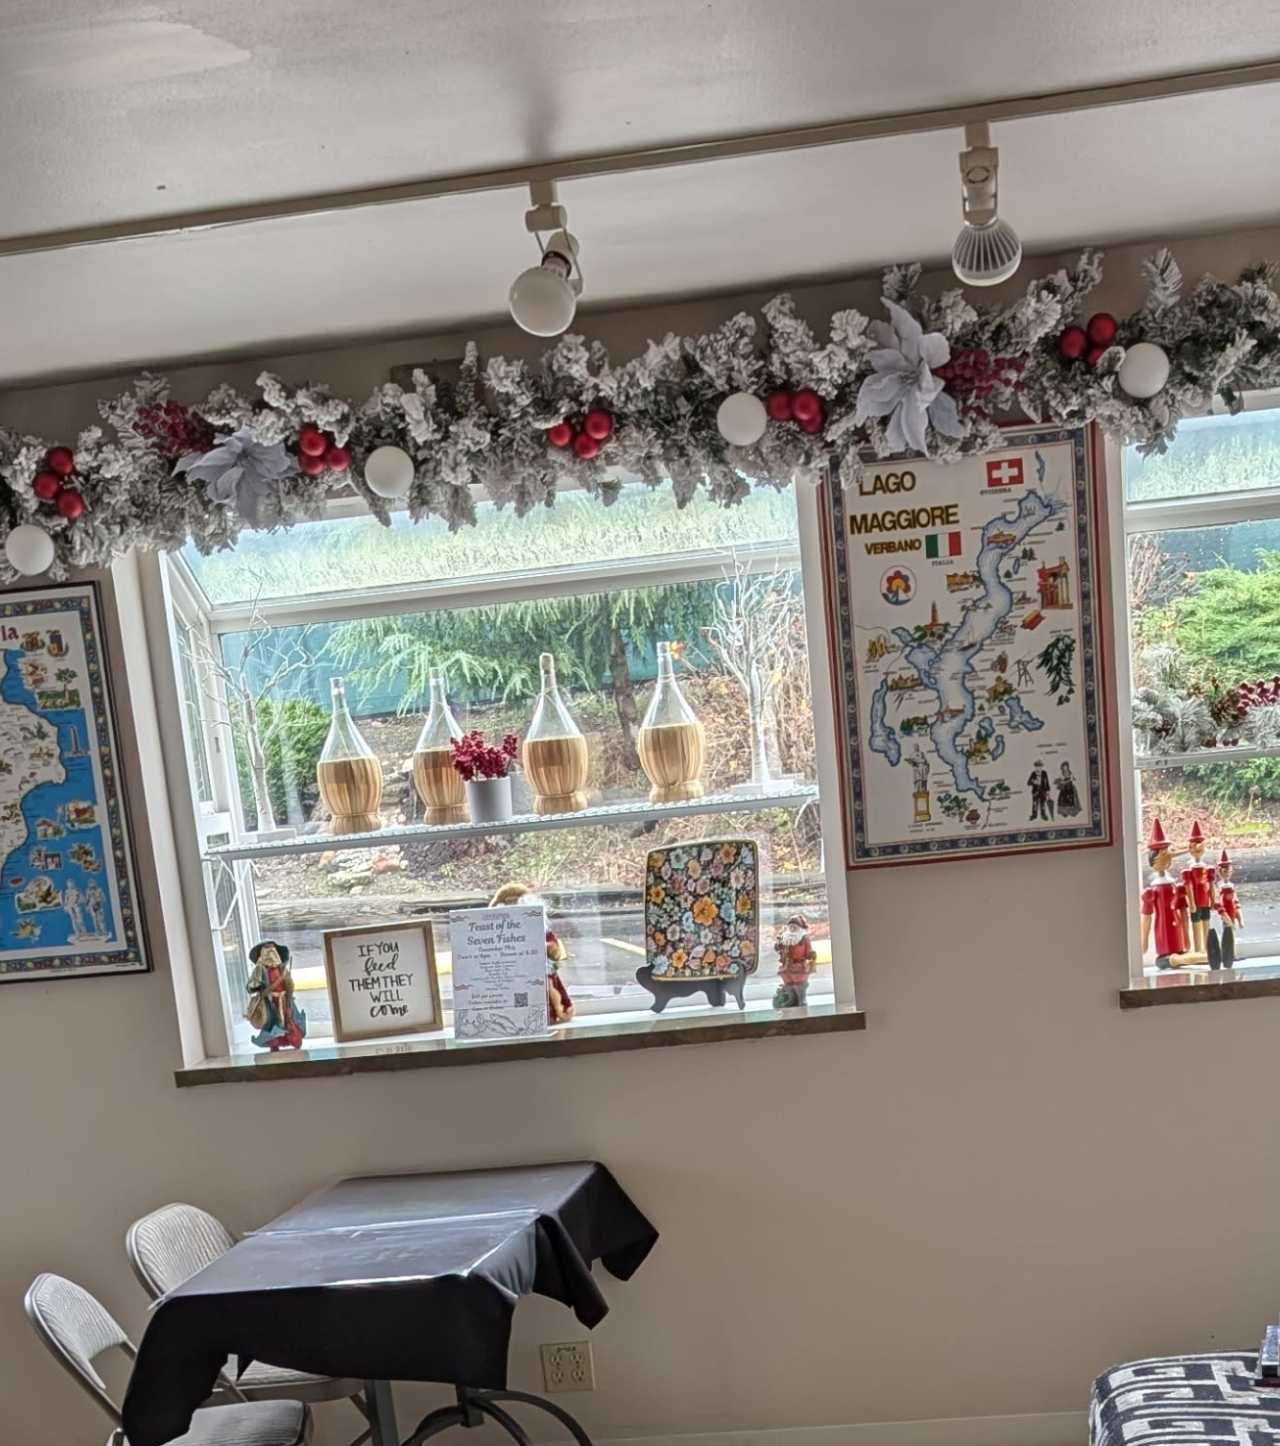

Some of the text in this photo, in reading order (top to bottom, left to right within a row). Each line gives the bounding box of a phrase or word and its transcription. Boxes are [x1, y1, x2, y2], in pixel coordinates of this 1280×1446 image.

[858, 471, 916, 496] LAGO
[849, 504, 960, 535] MAGGIORE
[865, 538, 922, 555] VERBANO
[357, 941, 399, 957] IF YOU
[364, 953, 399, 976] feed
[348, 973, 414, 992] THEM THEY
[369, 989, 404, 1003] WILL
